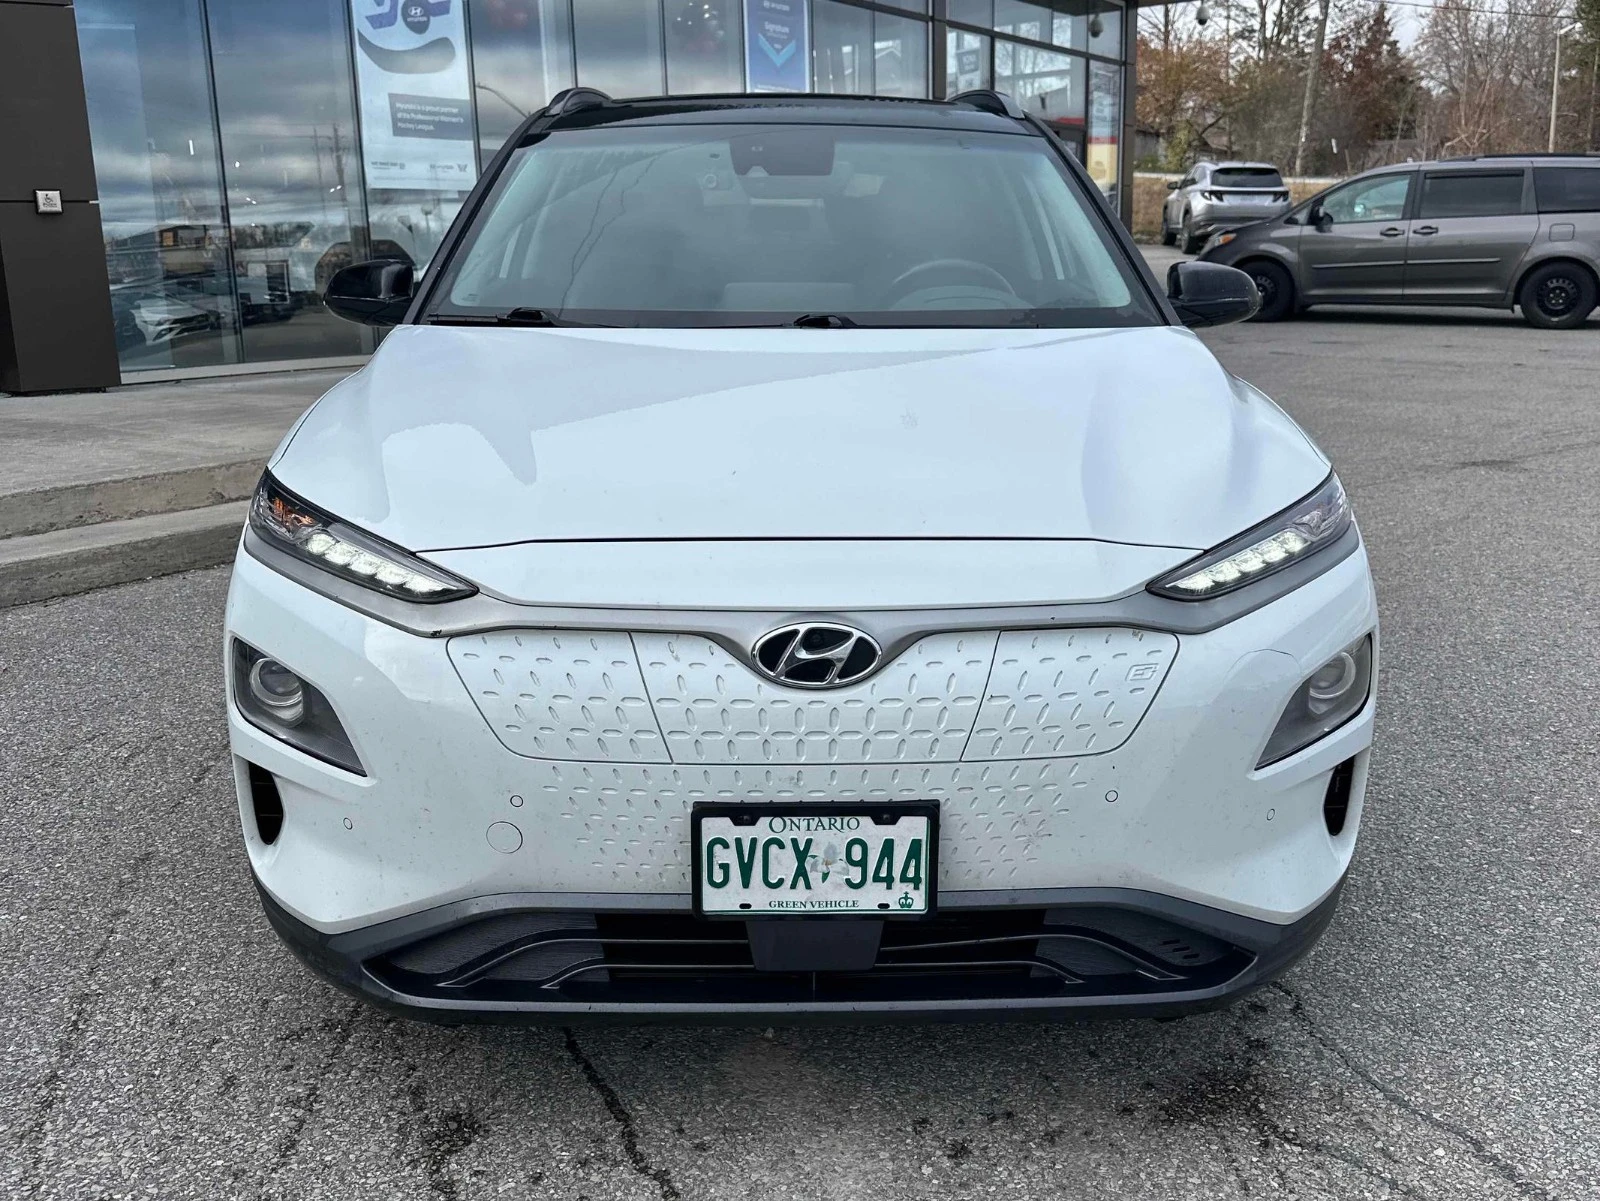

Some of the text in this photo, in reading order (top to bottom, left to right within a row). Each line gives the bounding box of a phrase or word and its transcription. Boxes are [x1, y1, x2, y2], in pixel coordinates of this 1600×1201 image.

[768, 816, 860, 834] ONTARIO
[706, 836, 923, 891] GVCX 944
[768, 900, 860, 909] GREEN VEHICLE
